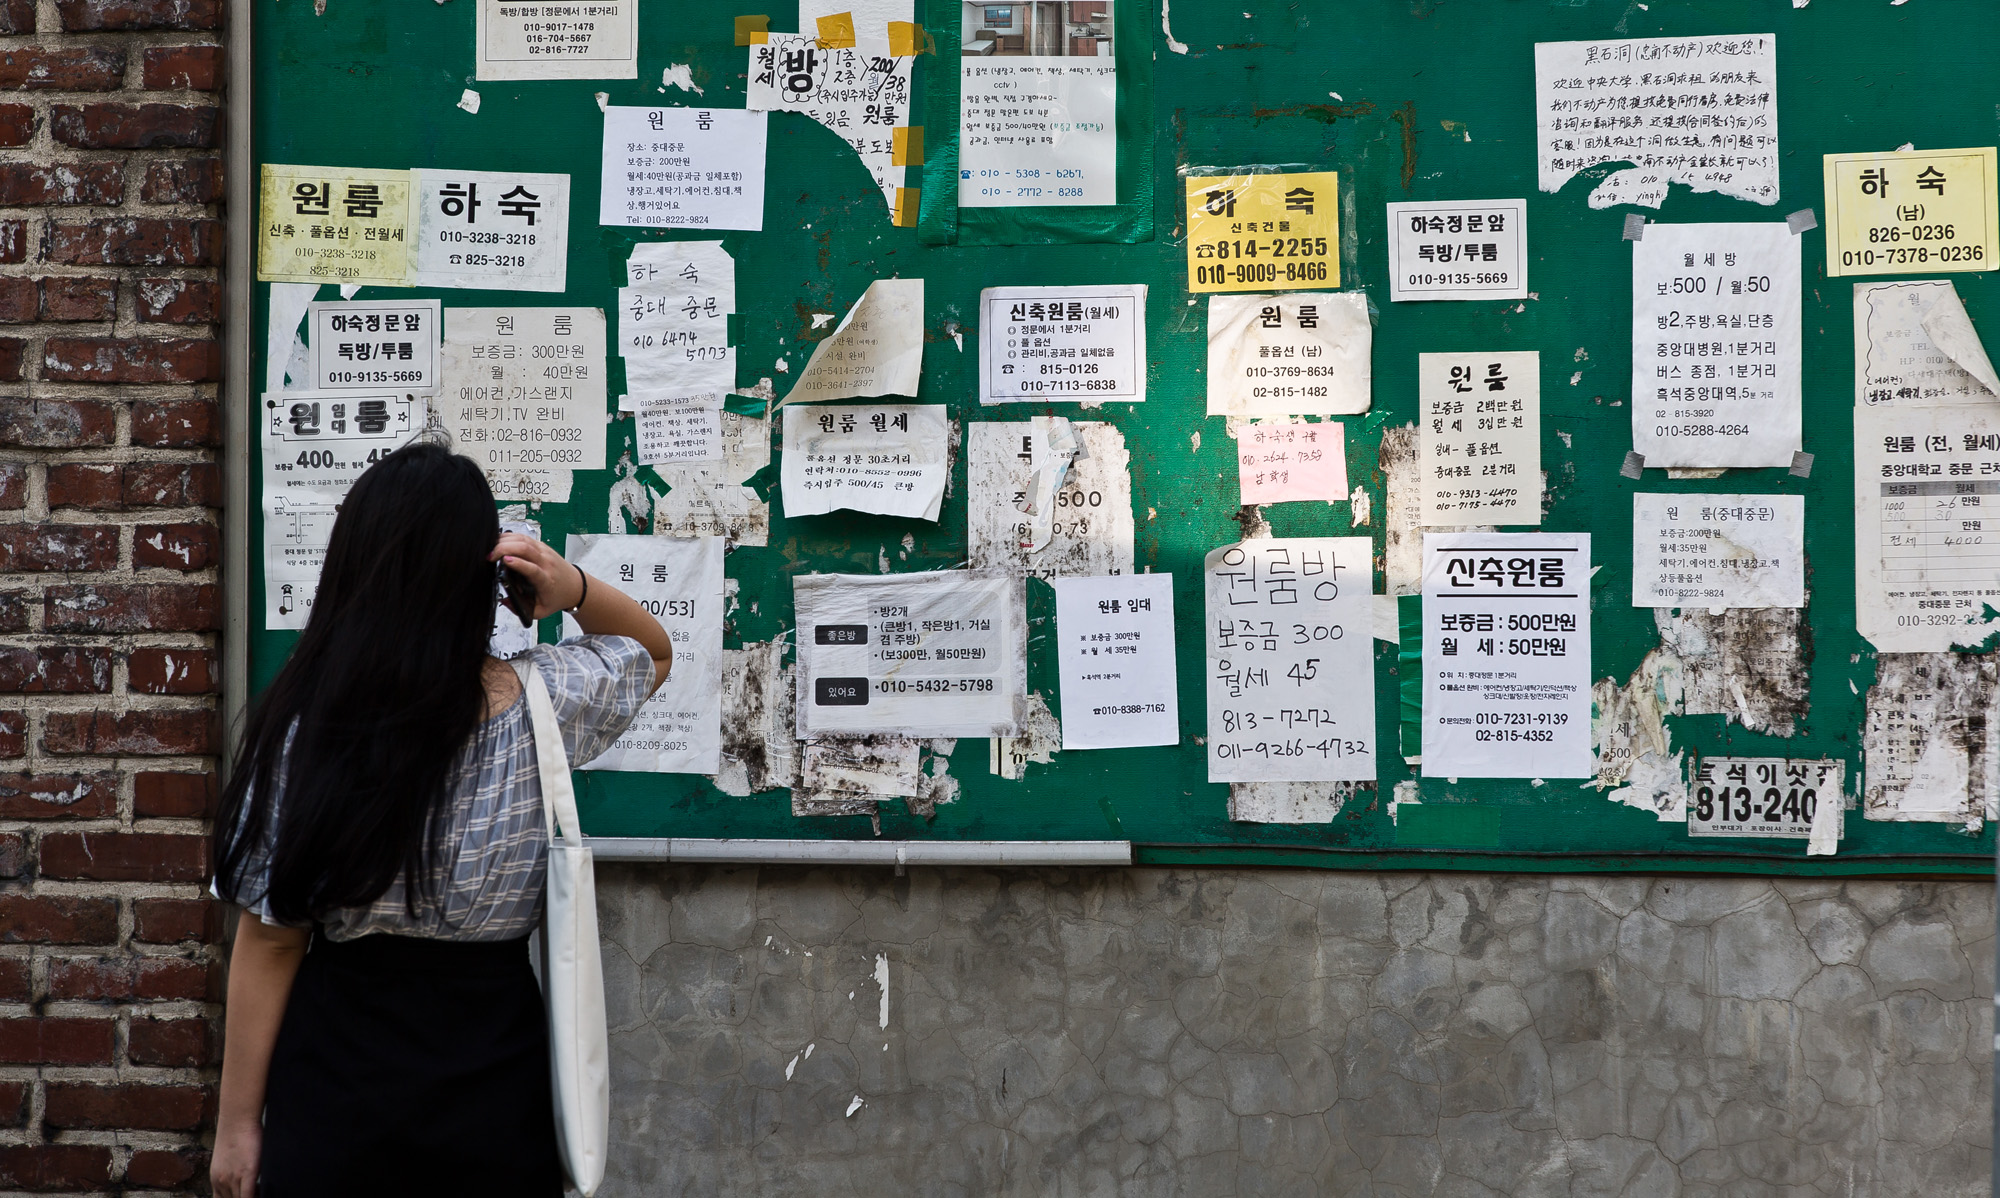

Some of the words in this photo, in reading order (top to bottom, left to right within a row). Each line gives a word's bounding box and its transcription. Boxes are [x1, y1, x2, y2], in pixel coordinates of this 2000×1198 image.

[500, 7, 538, 17] 독방/합방
[541, 7, 579, 16] [정문에서
[584, 7, 617, 15] 1분거리]
[524, 23, 594, 31] 010-9017-1478
[786, 49, 818, 92] 방
[863, 105, 899, 125] 원룸
[627, 143, 646, 151] 장소:
[651, 143, 685, 152] 중대중문
[627, 158, 654, 166] 보증금:
[659, 157, 690, 166] 200만원
[706, 172, 742, 181] 일체포함)
[1897, 204, 1925, 221] (남)
[646, 216, 708, 224] 010-8222-9824
[270, 224, 295, 237] 신축
[310, 225, 349, 239] 풀옵션
[364, 227, 404, 241] 전월세
[440, 231, 536, 246] 010-3238-3218
[1869, 225, 1955, 242] 826-0236
[295, 248, 376, 259] 010-3238-3218
[1218, 238, 1327, 259] 814-2255
[1418, 244, 1498, 263] 독방/투룸
[466, 254, 525, 267] 825-3218
[1843, 246, 1983, 266] 010-7378-0236
[310, 266, 359, 276] 825-3218
[1197, 262, 1327, 284] 010-9009-8466
[1409, 272, 1508, 285] 010-9135-5669
[630, 295, 666, 321] 중대
[1021, 325, 1055, 334] 정문에서
[1060, 325, 1090, 333] 1분거리
[634, 335, 652, 349] 010
[662, 331, 698, 346] 6474
[338, 343, 413, 360] 독방/투룸
[472, 345, 522, 359] 보증금:
[532, 345, 584, 358] 300만원
[687, 348, 726, 360] 5773
[849, 351, 865, 361] 완비
[1081, 348, 1114, 357] 일체없음
[1259, 346, 1294, 358] 풀옵션
[1301, 346, 1322, 357] (남)
[543, 366, 588, 379] 40만원
[808, 366, 875, 376] 010-5414-2704
[1040, 364, 1098, 374] 815-0126
[1246, 367, 1334, 377] 010-3769-8634
[1657, 366, 1682, 378] 버스
[1691, 365, 1721, 378] 종점,
[1729, 364, 1776, 378] 1분거리
[329, 371, 422, 382] 010-9135-5669
[806, 380, 873, 390] 010-3641-2397
[1021, 380, 1116, 391] 010-7113-6838
[1253, 387, 1328, 397] 02-815-1482
[640, 398, 689, 406] 010-5233-1573
[537, 408, 564, 421] 완비
[1432, 402, 1464, 415] 보증금
[818, 414, 857, 433] 원룸
[869, 413, 908, 433] 월세
[1656, 425, 1749, 437] 010-5288-4264
[1465, 442, 1502, 457] 풀옵션
[1884, 436, 1915, 453] 원룸
[1925, 434, 1952, 452] (전,
[296, 450, 334, 469] 400
[490, 449, 582, 462] 011-205-0932
[868, 454, 911, 464] 30초거리
[1434, 466, 1471, 478] 중대중문
[1482, 464, 1516, 476] 2분거리
[1881, 464, 1942, 477] 중앙대학교
[1949, 463, 1973, 475] 중문
[848, 480, 883, 489] 500/45
[1956, 484, 1975, 493] 월세
[1058, 491, 1102, 507] 500
[1437, 488, 1517, 498] 010-9313-4470
[1436, 499, 1516, 510] 010-7175-4470
[1962, 497, 1980, 506] 만원
[1962, 521, 1981, 530] 만원
[1660, 529, 1721, 538] 보증금:200만원
[1659, 544, 1707, 553] 월세:35만원
[1216, 548, 1346, 605] 원룸방
[1446, 557, 1565, 587] 신축원룸
[1659, 574, 1703, 583] 상등풀옵션
[1659, 589, 1724, 598] 010-8222-9824
[1098, 600, 1121, 613] 원룸
[1128, 598, 1151, 612] 임대
[1918, 600, 1951, 608] 중대중문
[1955, 599, 1971, 608] 근처
[880, 606, 908, 617] 방2개
[880, 621, 917, 633] (큰방1,
[921, 621, 964, 632] 작은방1,
[969, 619, 990, 630] 거실
[1441, 614, 1493, 632] 보증금
[1508, 614, 1576, 632] 500만원
[672, 631, 690, 642] 없음
[827, 630, 856, 640] 좋은방
[895, 633, 921, 645] 주방)
[1115, 632, 1140, 640] 300만원
[1219, 620, 1279, 651] 보증금
[1293, 625, 1343, 644] 300
[1115, 646, 1137, 654] 35만원
[1508, 638, 1565, 656] 50만원
[676, 652, 694, 662] 거리
[881, 651, 930, 661] (보300만,
[935, 648, 986, 660] 월50만원)
[1217, 660, 1268, 697] 월세
[1287, 659, 1320, 687] 45
[828, 687, 856, 697] 있어요
[881, 679, 993, 693] 010-5432-5798
[1102, 704, 1165, 715] 010-8388-7162
[1222, 709, 1336, 733] 813-7272
[1476, 713, 1568, 725] 010-7231-9139
[1476, 730, 1553, 741] 02-815-4352
[615, 740, 687, 750] 010-8209-8025
[1218, 739, 1369, 758] 011-9266-4732
